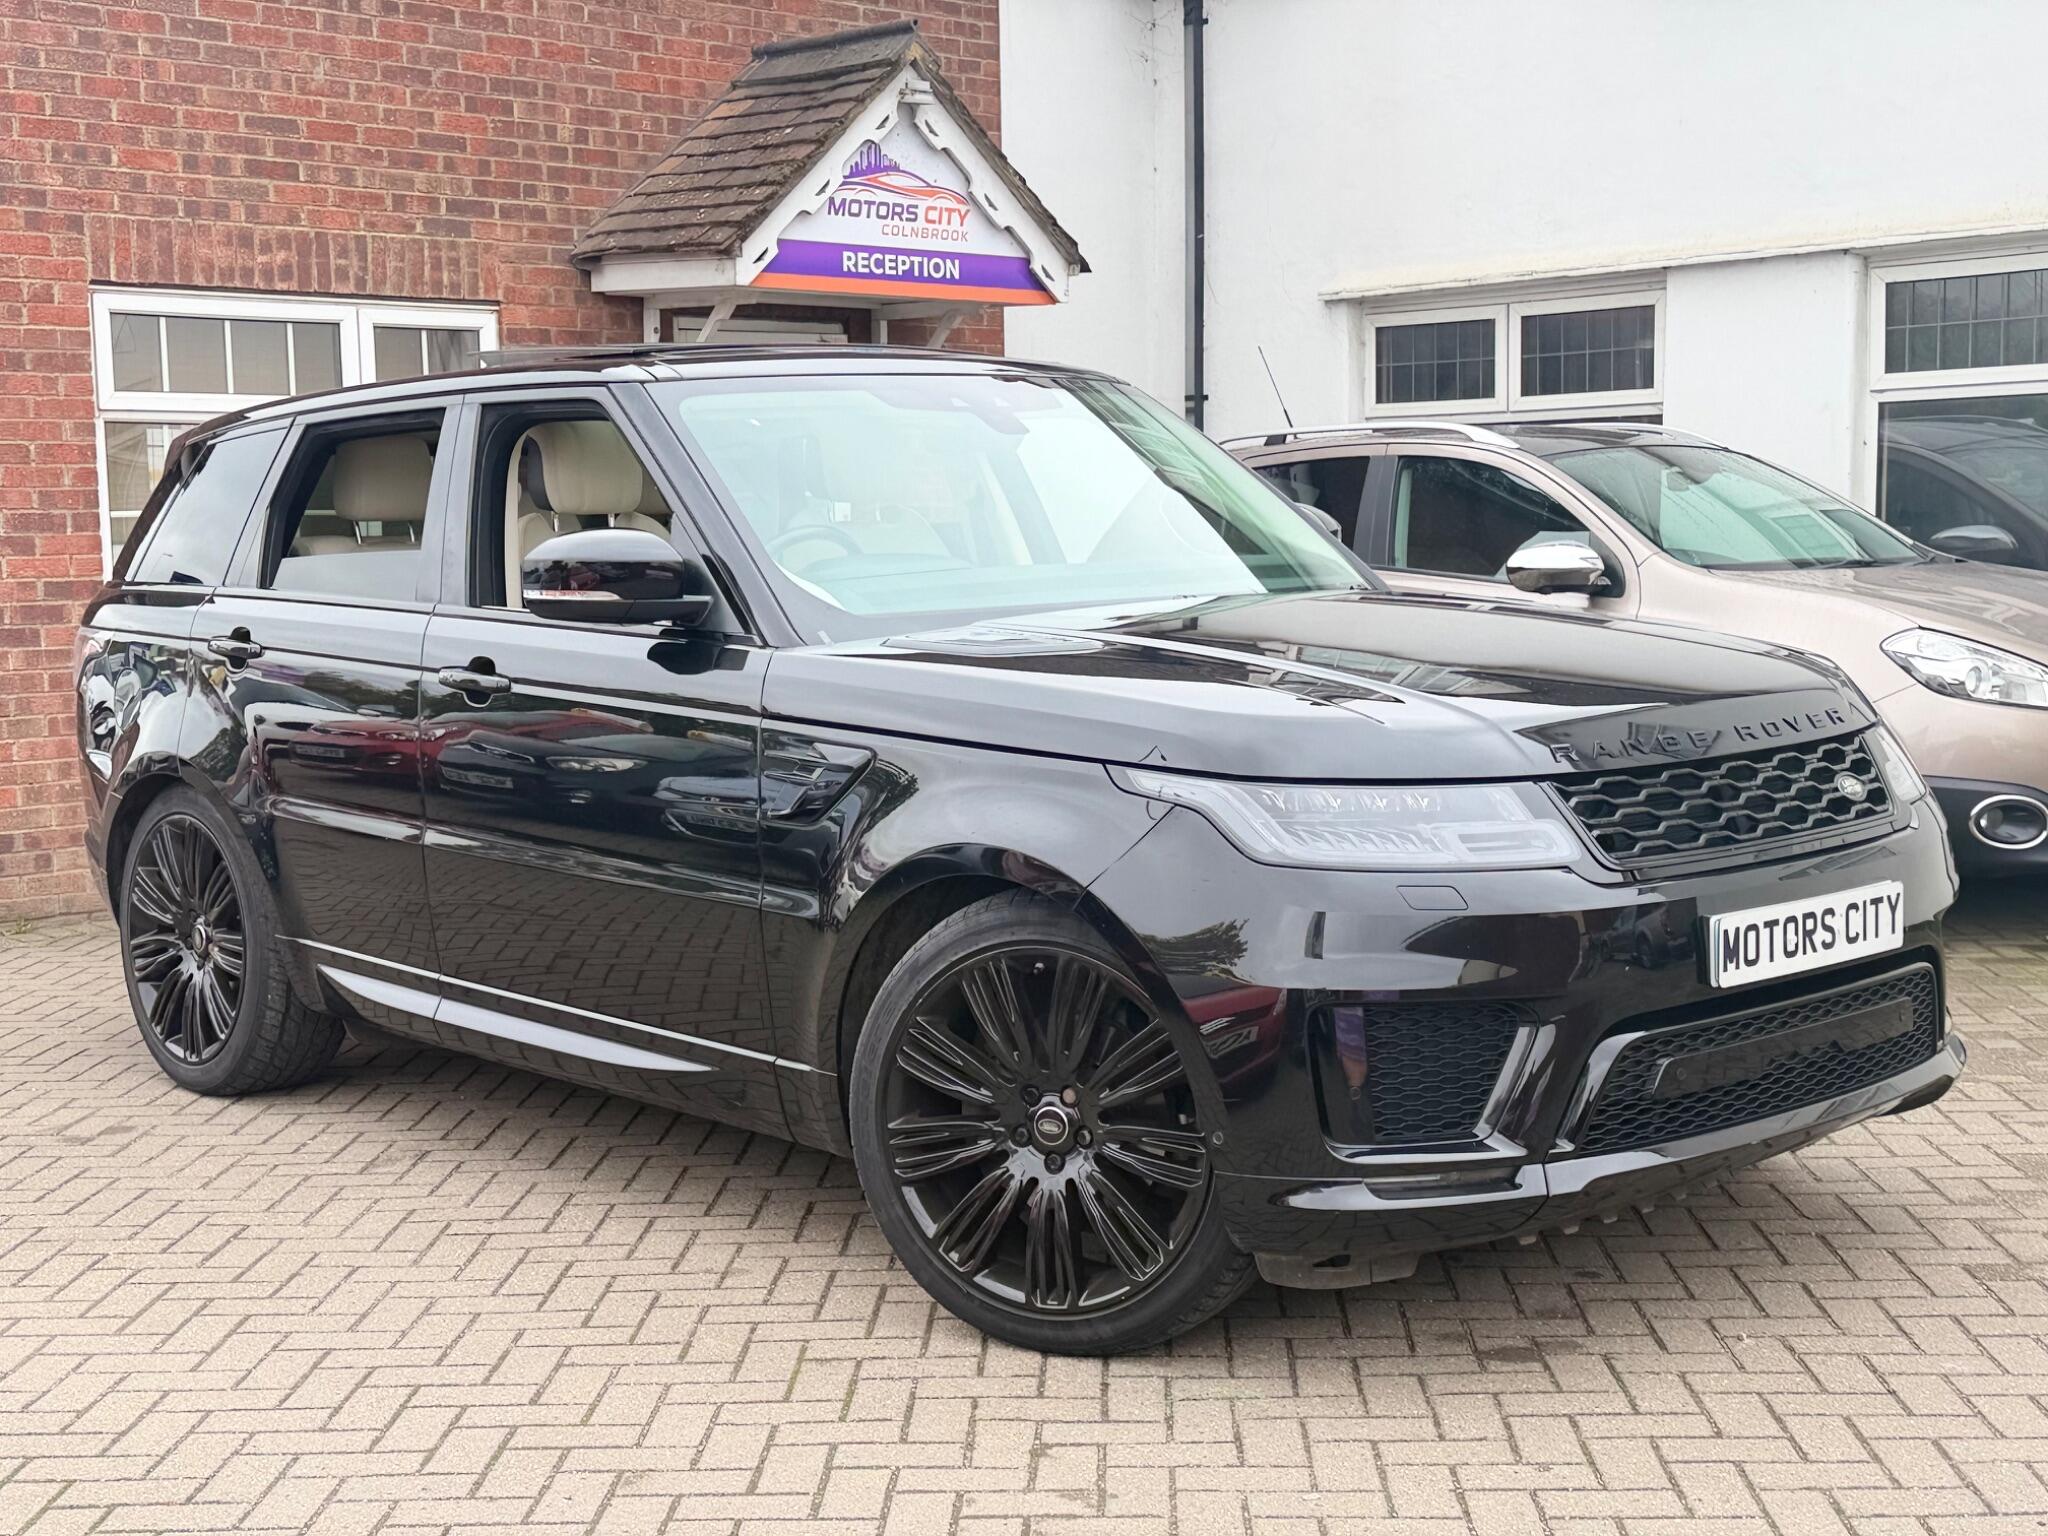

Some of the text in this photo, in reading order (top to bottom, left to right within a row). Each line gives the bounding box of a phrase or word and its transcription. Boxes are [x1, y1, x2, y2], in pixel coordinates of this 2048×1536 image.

[827, 196, 971, 227] MOTORS CITY
[881, 223, 969, 242] COLNBROOK
[842, 251, 960, 279] RECEPTION
[1550, 707, 1845, 763] RANGE ROVER
[1723, 892, 1901, 972] MOTORS CITY
